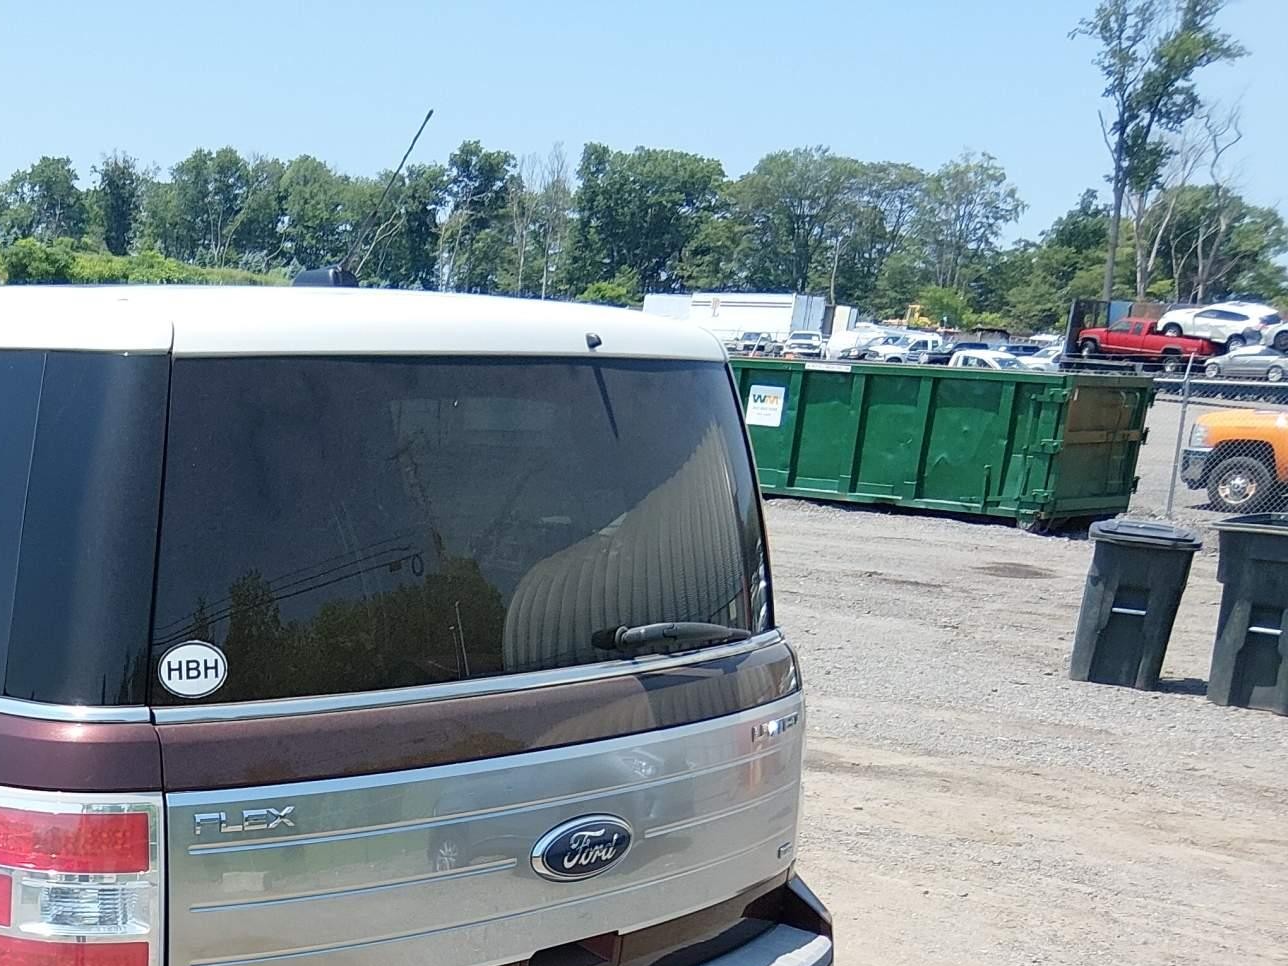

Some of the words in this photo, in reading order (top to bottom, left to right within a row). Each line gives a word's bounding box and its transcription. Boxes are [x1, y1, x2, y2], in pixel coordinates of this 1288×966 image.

[166, 658, 220, 681] HBH
[193, 805, 296, 835] FLEX
[563, 829, 618, 869] Ford
